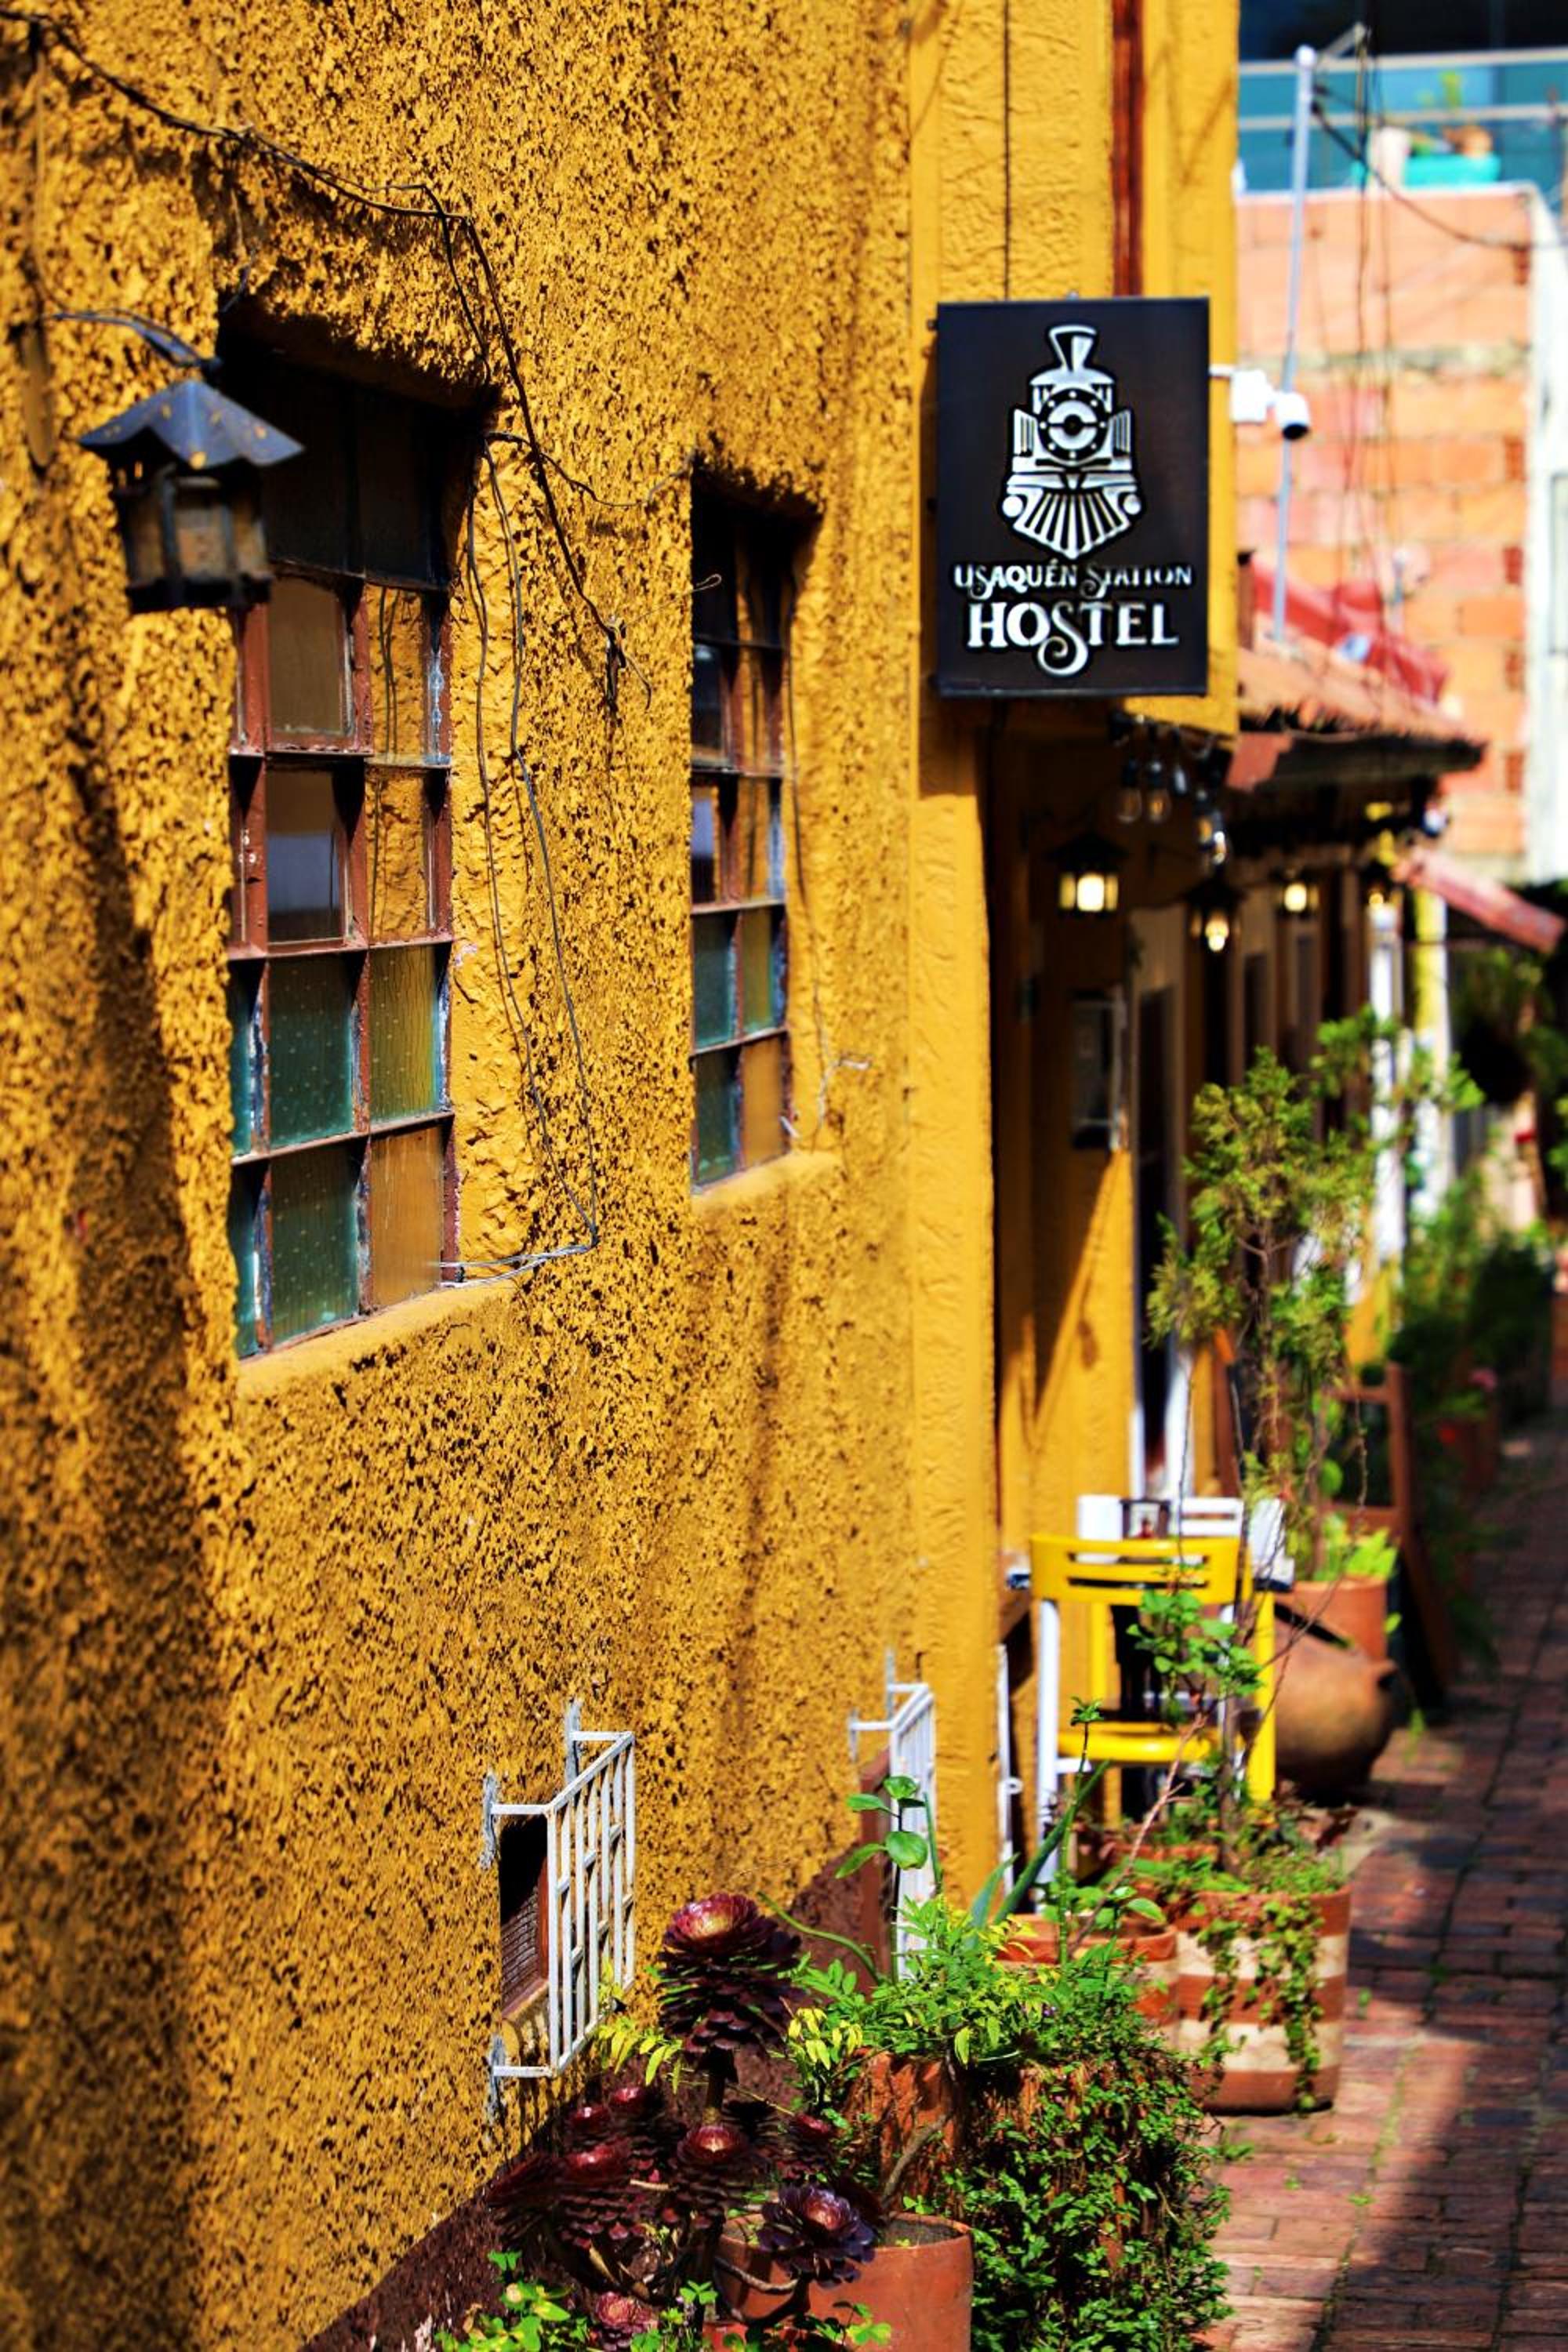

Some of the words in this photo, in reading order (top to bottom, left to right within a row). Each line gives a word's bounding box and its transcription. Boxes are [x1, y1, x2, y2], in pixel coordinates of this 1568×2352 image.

[954, 558, 1077, 600] USAQUÉN
[1080, 562, 1192, 598] STATION
[967, 601, 1179, 676] HOSTEL
